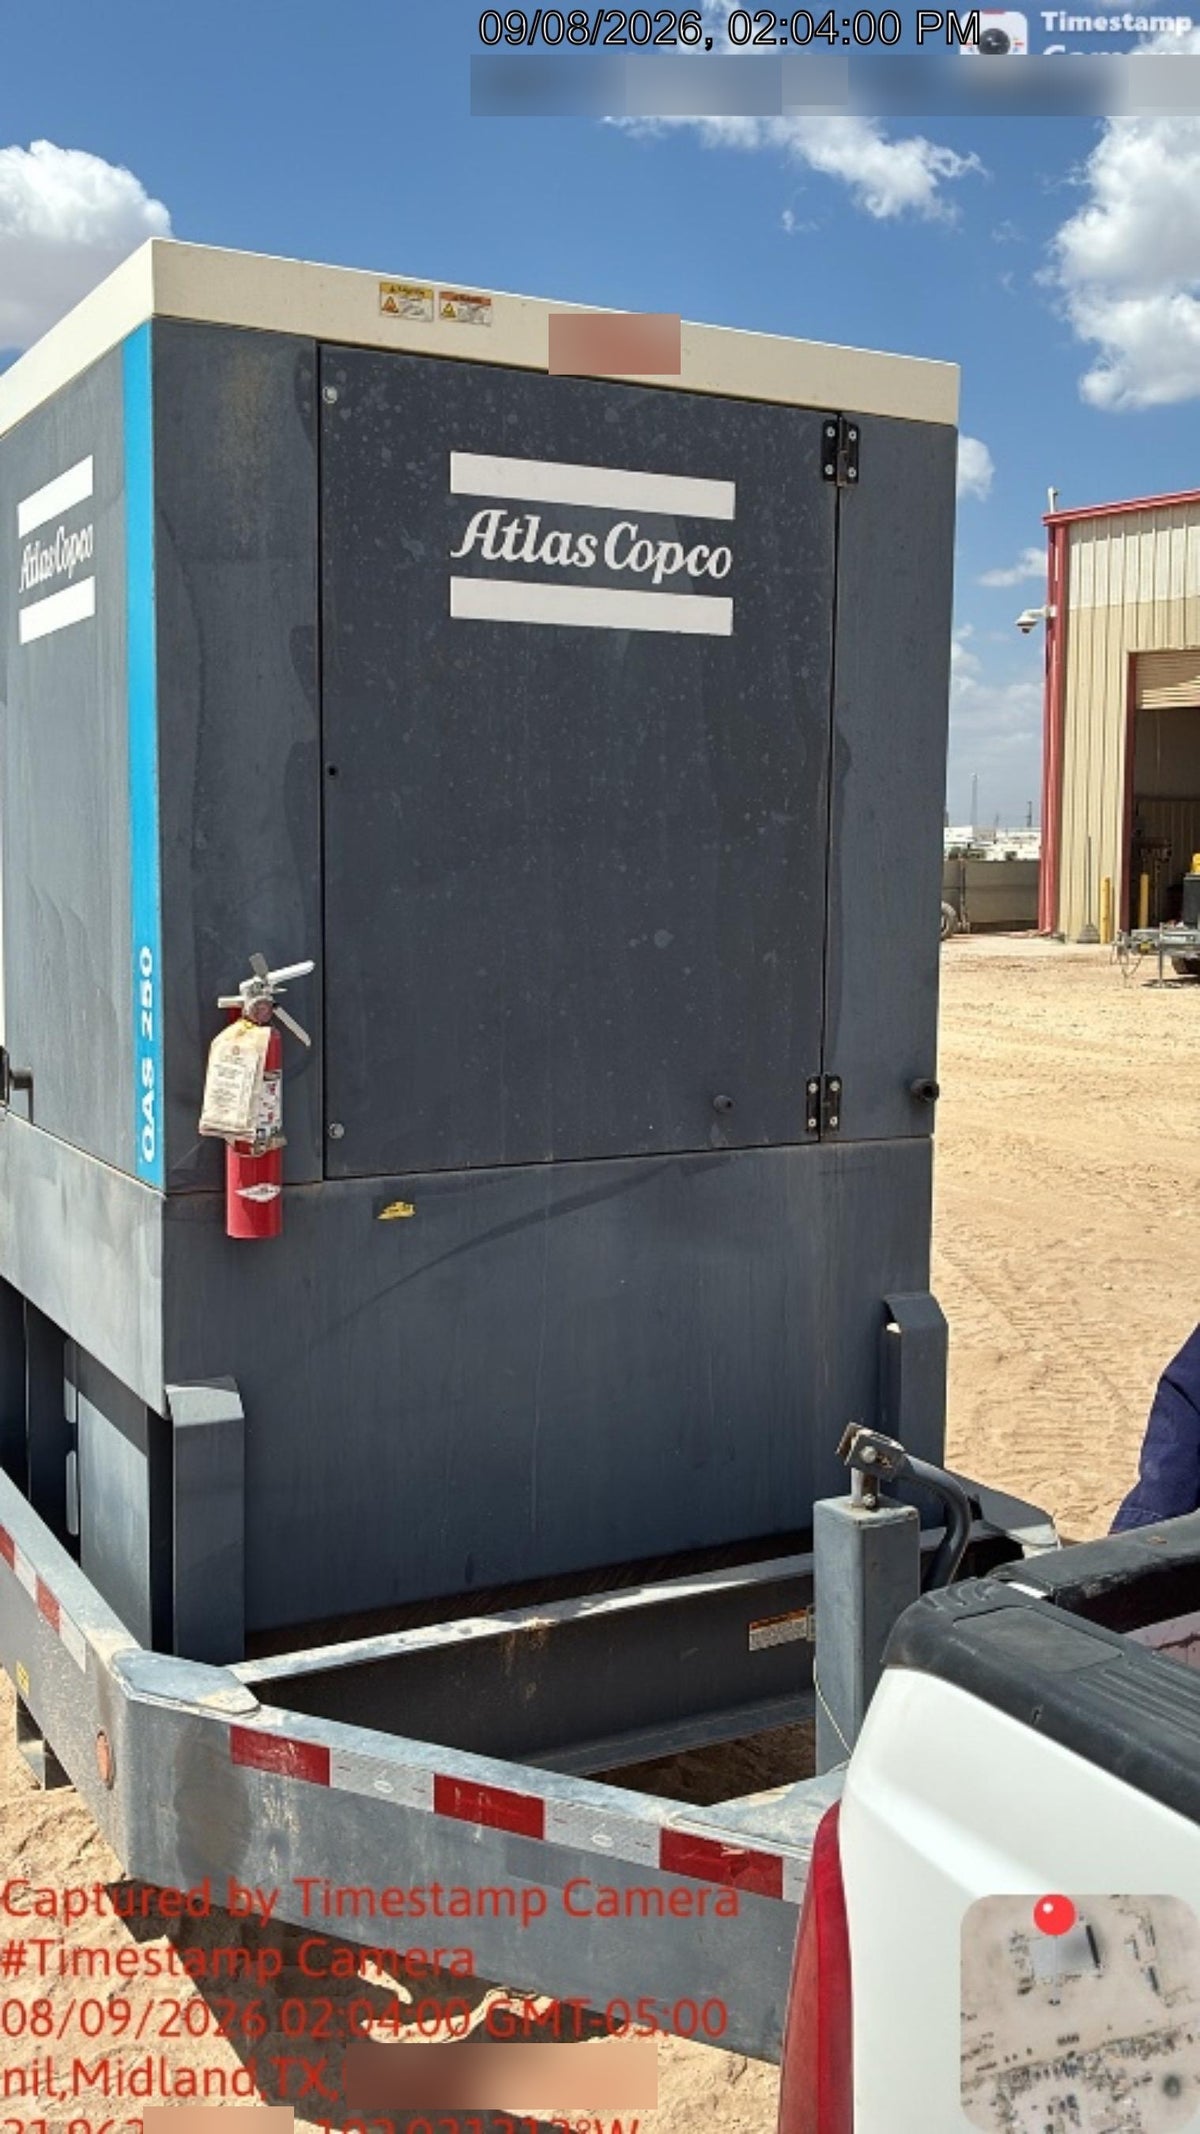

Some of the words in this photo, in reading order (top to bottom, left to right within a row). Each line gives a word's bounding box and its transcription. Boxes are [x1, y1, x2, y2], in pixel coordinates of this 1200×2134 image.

[450, 508, 598, 568] Atlas
[604, 521, 732, 585] Copco
[141, 1056, 155, 1163] QAS
